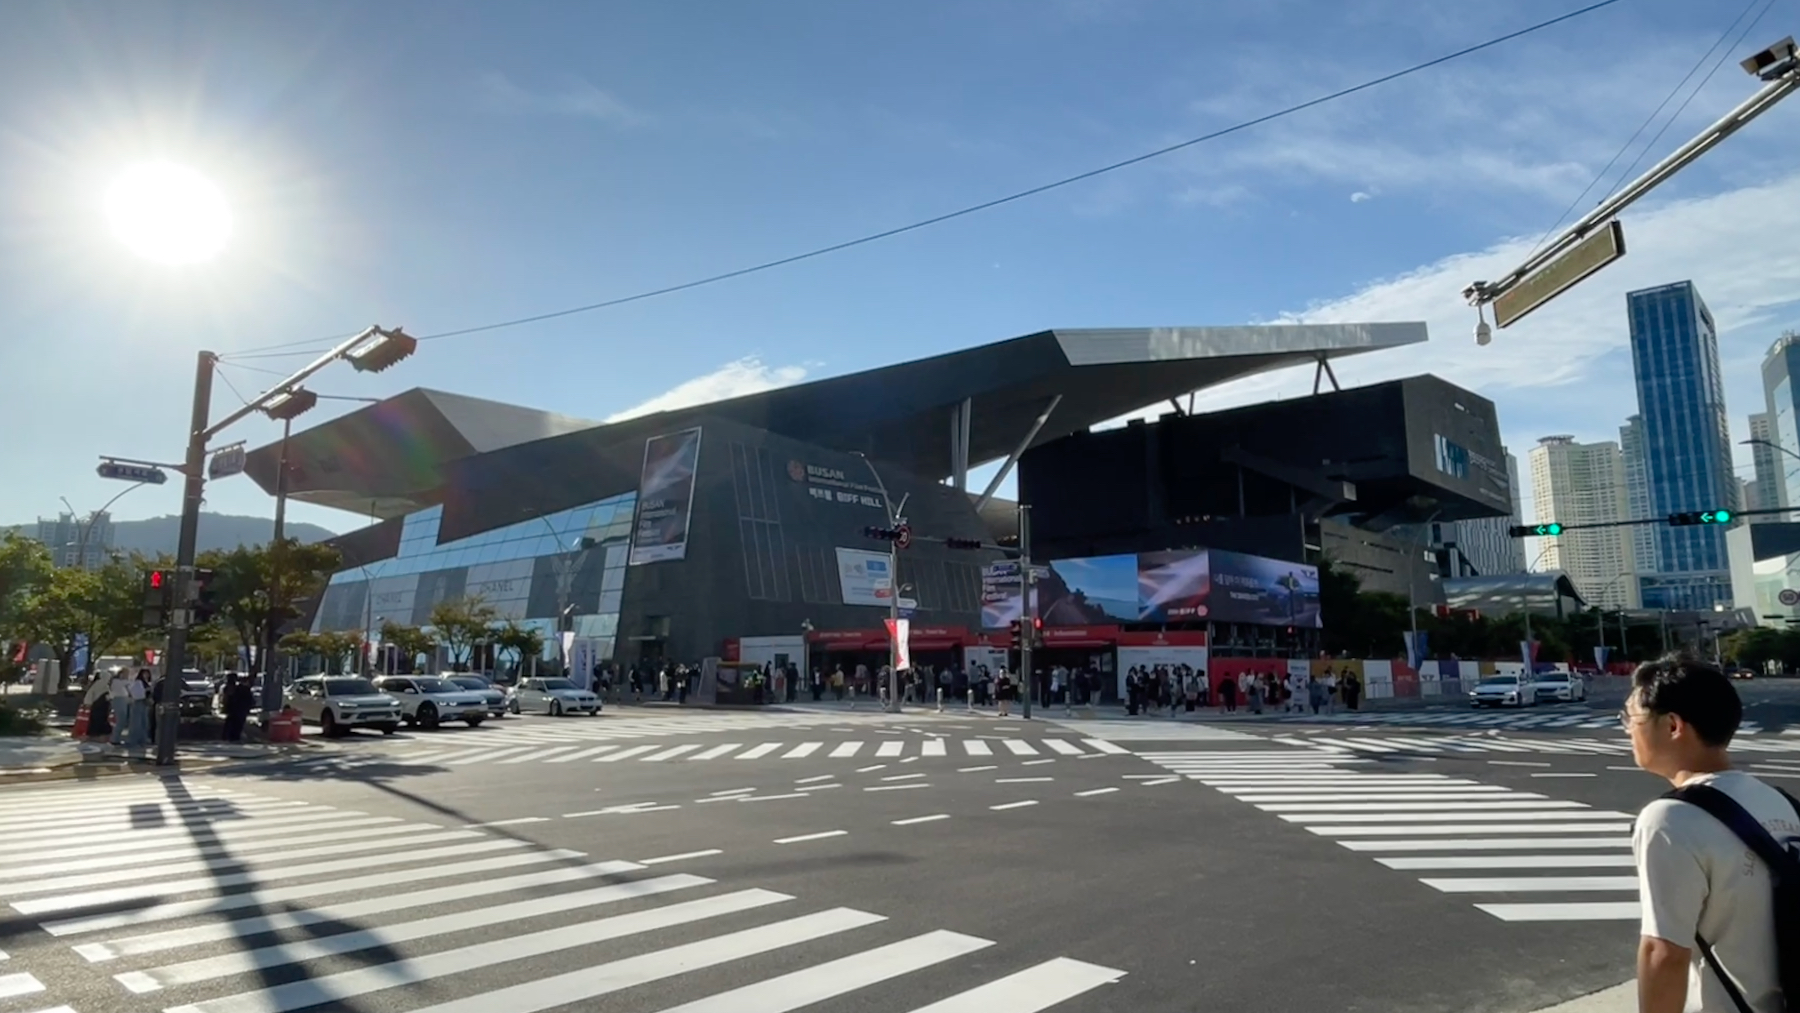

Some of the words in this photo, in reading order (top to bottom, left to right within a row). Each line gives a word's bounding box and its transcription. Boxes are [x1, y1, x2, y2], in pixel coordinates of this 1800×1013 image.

[807, 465, 845, 480] BUSAN
[836, 491, 860, 504] BIFF
[860, 496, 882, 508] HILL
